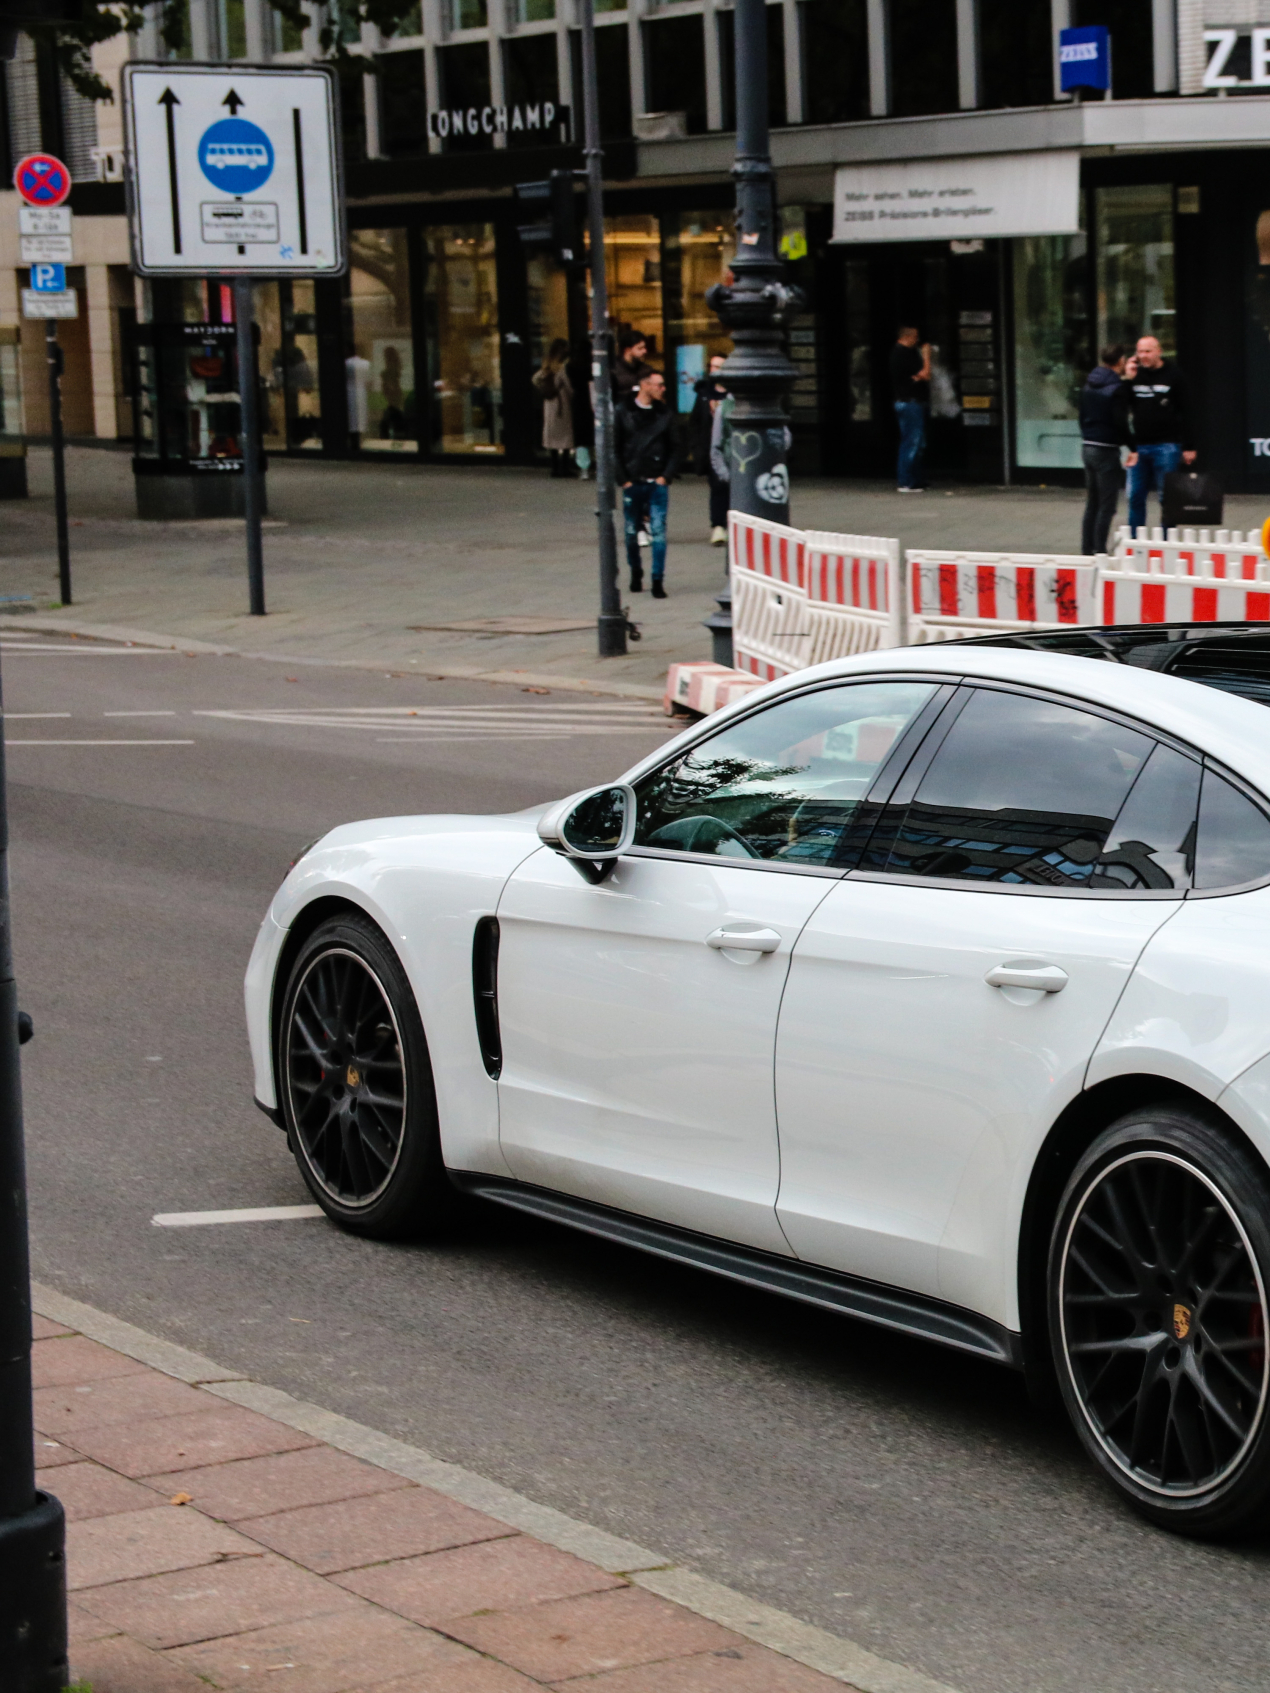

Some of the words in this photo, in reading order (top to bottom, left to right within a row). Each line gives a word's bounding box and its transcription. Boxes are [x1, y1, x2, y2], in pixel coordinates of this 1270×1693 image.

[1060, 42, 1098, 63] ZEISS
[427, 101, 556, 138] LONGCHAMP
[36, 266, 55, 288] P
